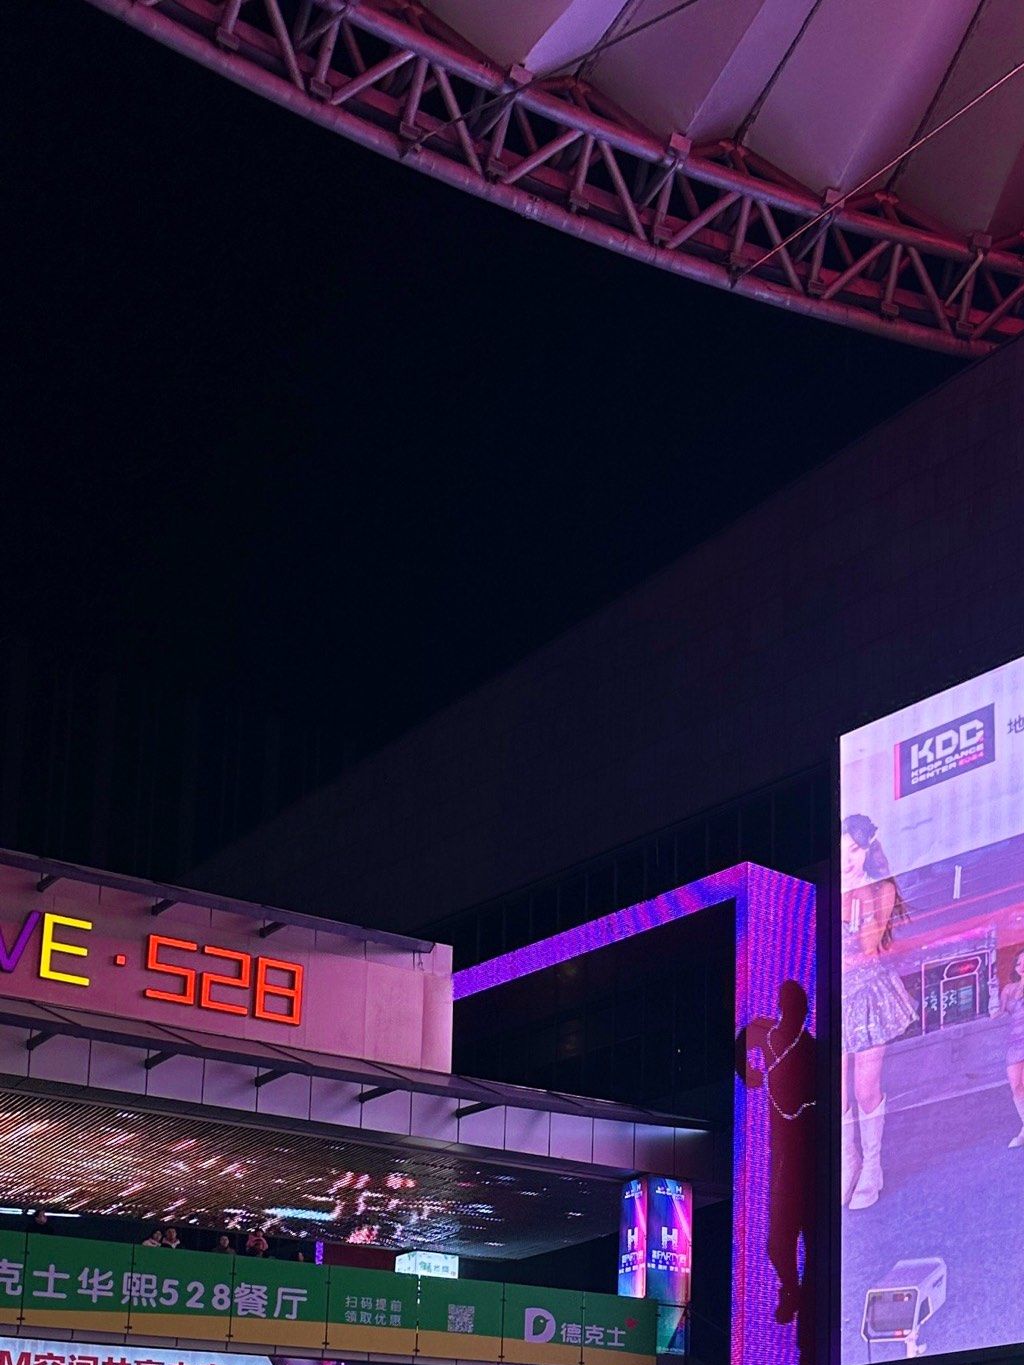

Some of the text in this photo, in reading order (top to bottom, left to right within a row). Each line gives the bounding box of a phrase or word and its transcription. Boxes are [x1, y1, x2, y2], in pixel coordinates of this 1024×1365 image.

[911, 719, 984, 770] KDC
[144, 934, 304, 1026] 528
[560, 1323, 626, 1347] 德克士
